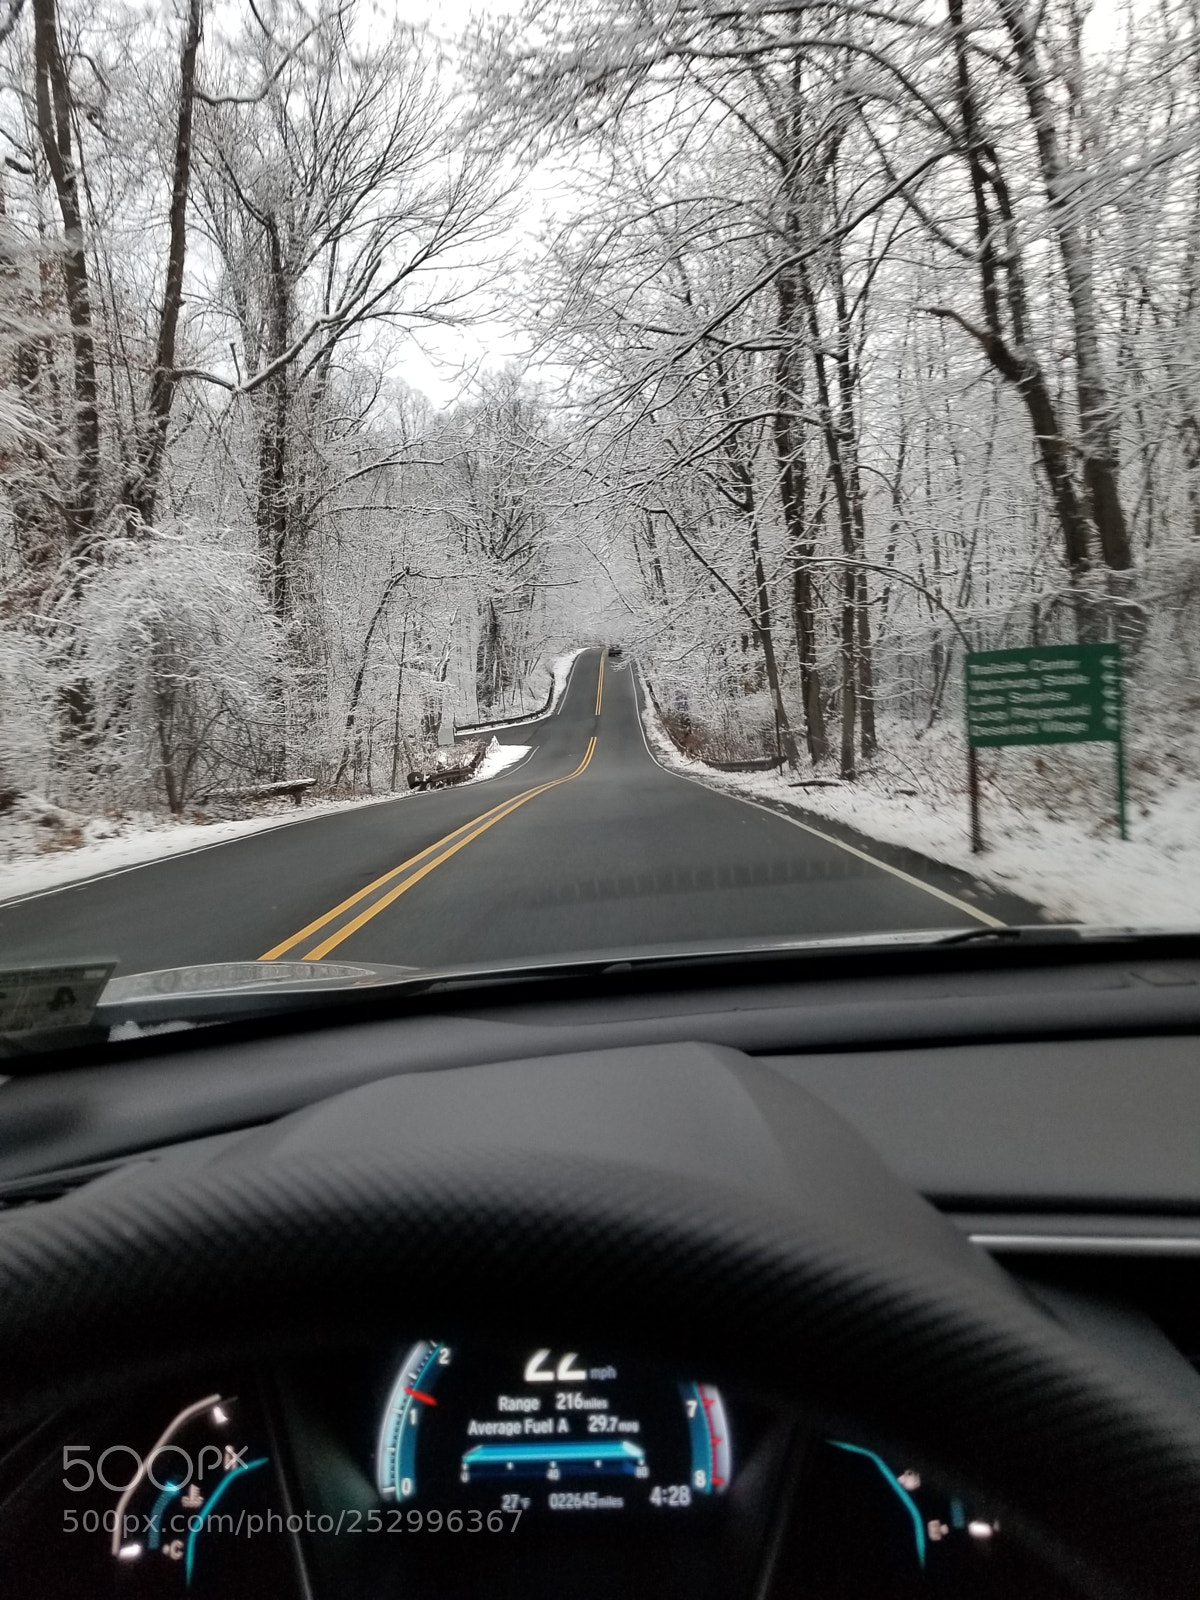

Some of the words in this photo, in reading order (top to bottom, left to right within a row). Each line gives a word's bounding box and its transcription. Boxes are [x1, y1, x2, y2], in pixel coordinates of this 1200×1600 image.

[438, 1348, 450, 1365] 2
[589, 1365, 617, 1381] mph
[498, 1396, 540, 1412] Range
[687, 1400, 698, 1418] 7
[409, 1407, 418, 1425] 1
[467, 1420, 522, 1436] Average
[524, 1418, 552, 1435] Fuel
[557, 1418, 569, 1434] A
[461, 1468, 470, 1483] 0
[693, 1470, 706, 1489] 8
[400, 1477, 413, 1496] 0
[650, 1486, 691, 1505] 4:28
